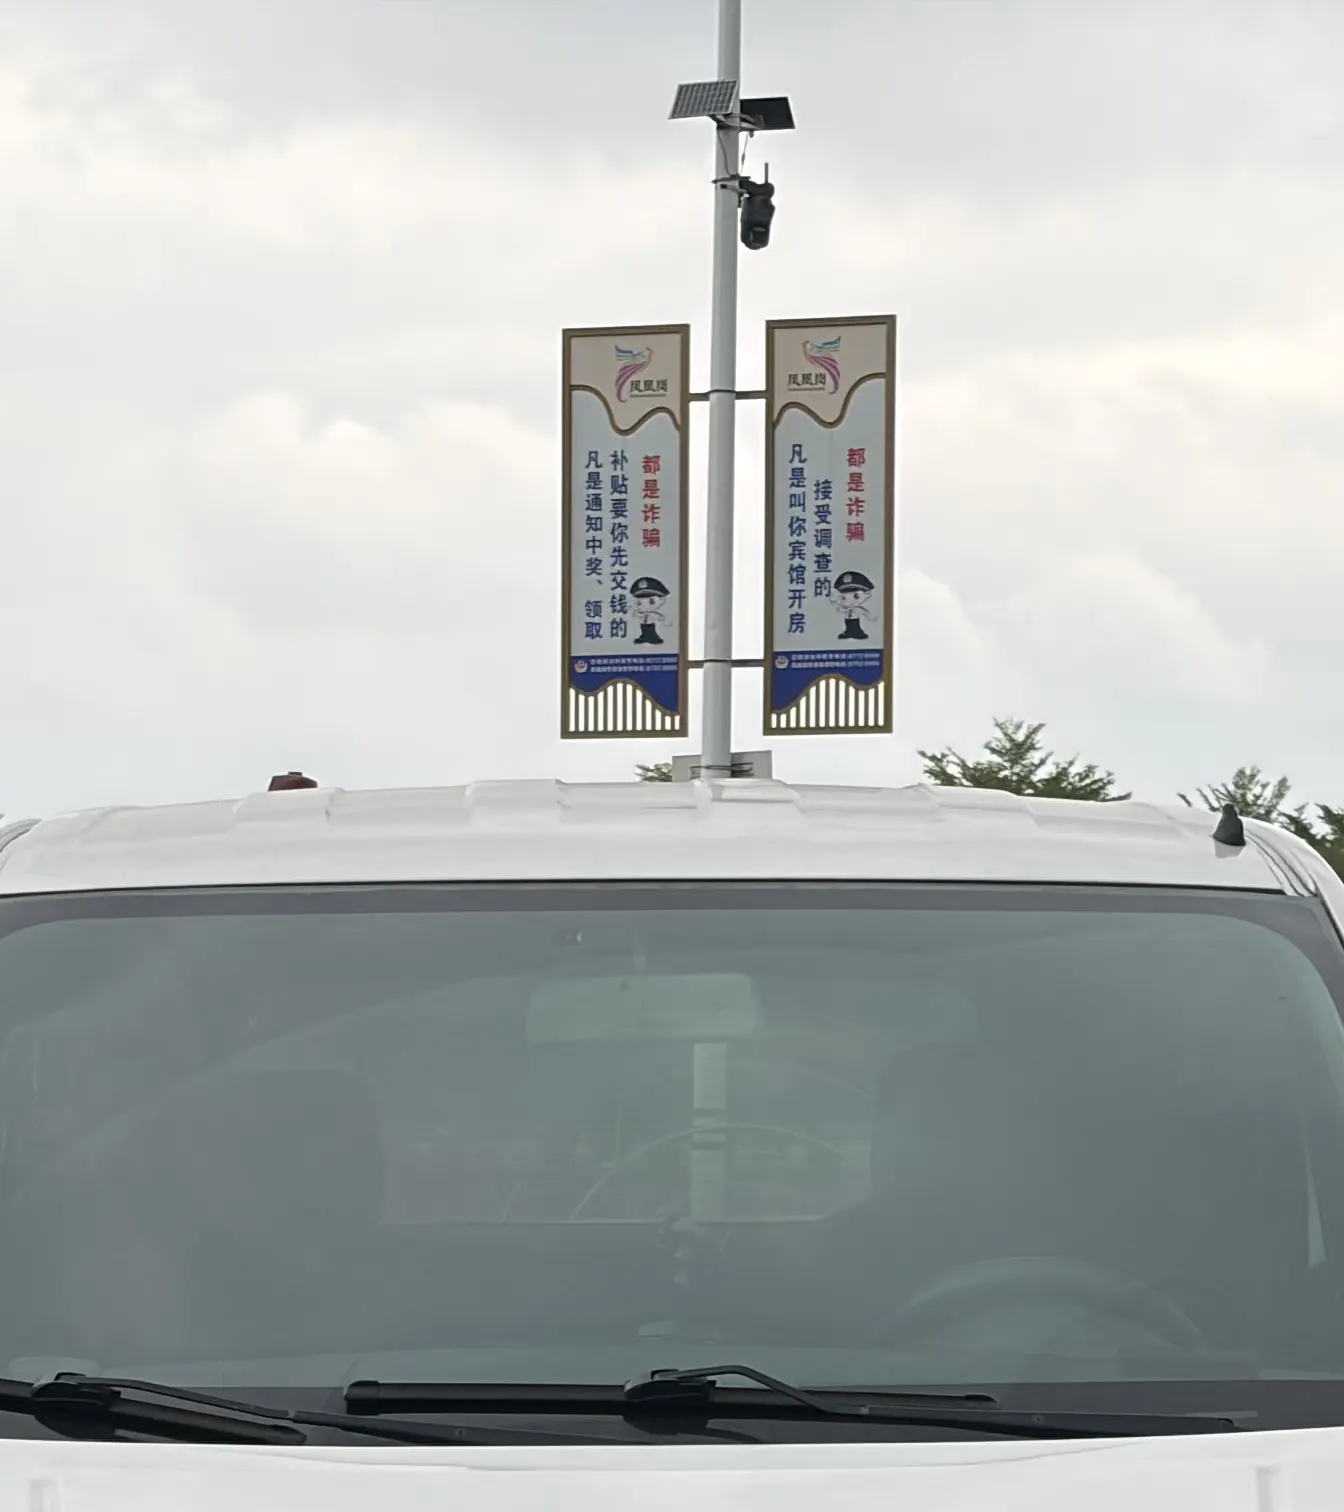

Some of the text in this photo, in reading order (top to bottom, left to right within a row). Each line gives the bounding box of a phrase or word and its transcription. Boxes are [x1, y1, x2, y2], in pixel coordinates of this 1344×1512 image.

[610, 449, 628, 639] 补贴要你先交钱的
[641, 455, 661, 548] 都是诈骗
[788, 444, 807, 634] 凡是叫你宾馆开房
[813, 479, 833, 598] 接受调查的
[846, 447, 866, 542] 都是诈骗
